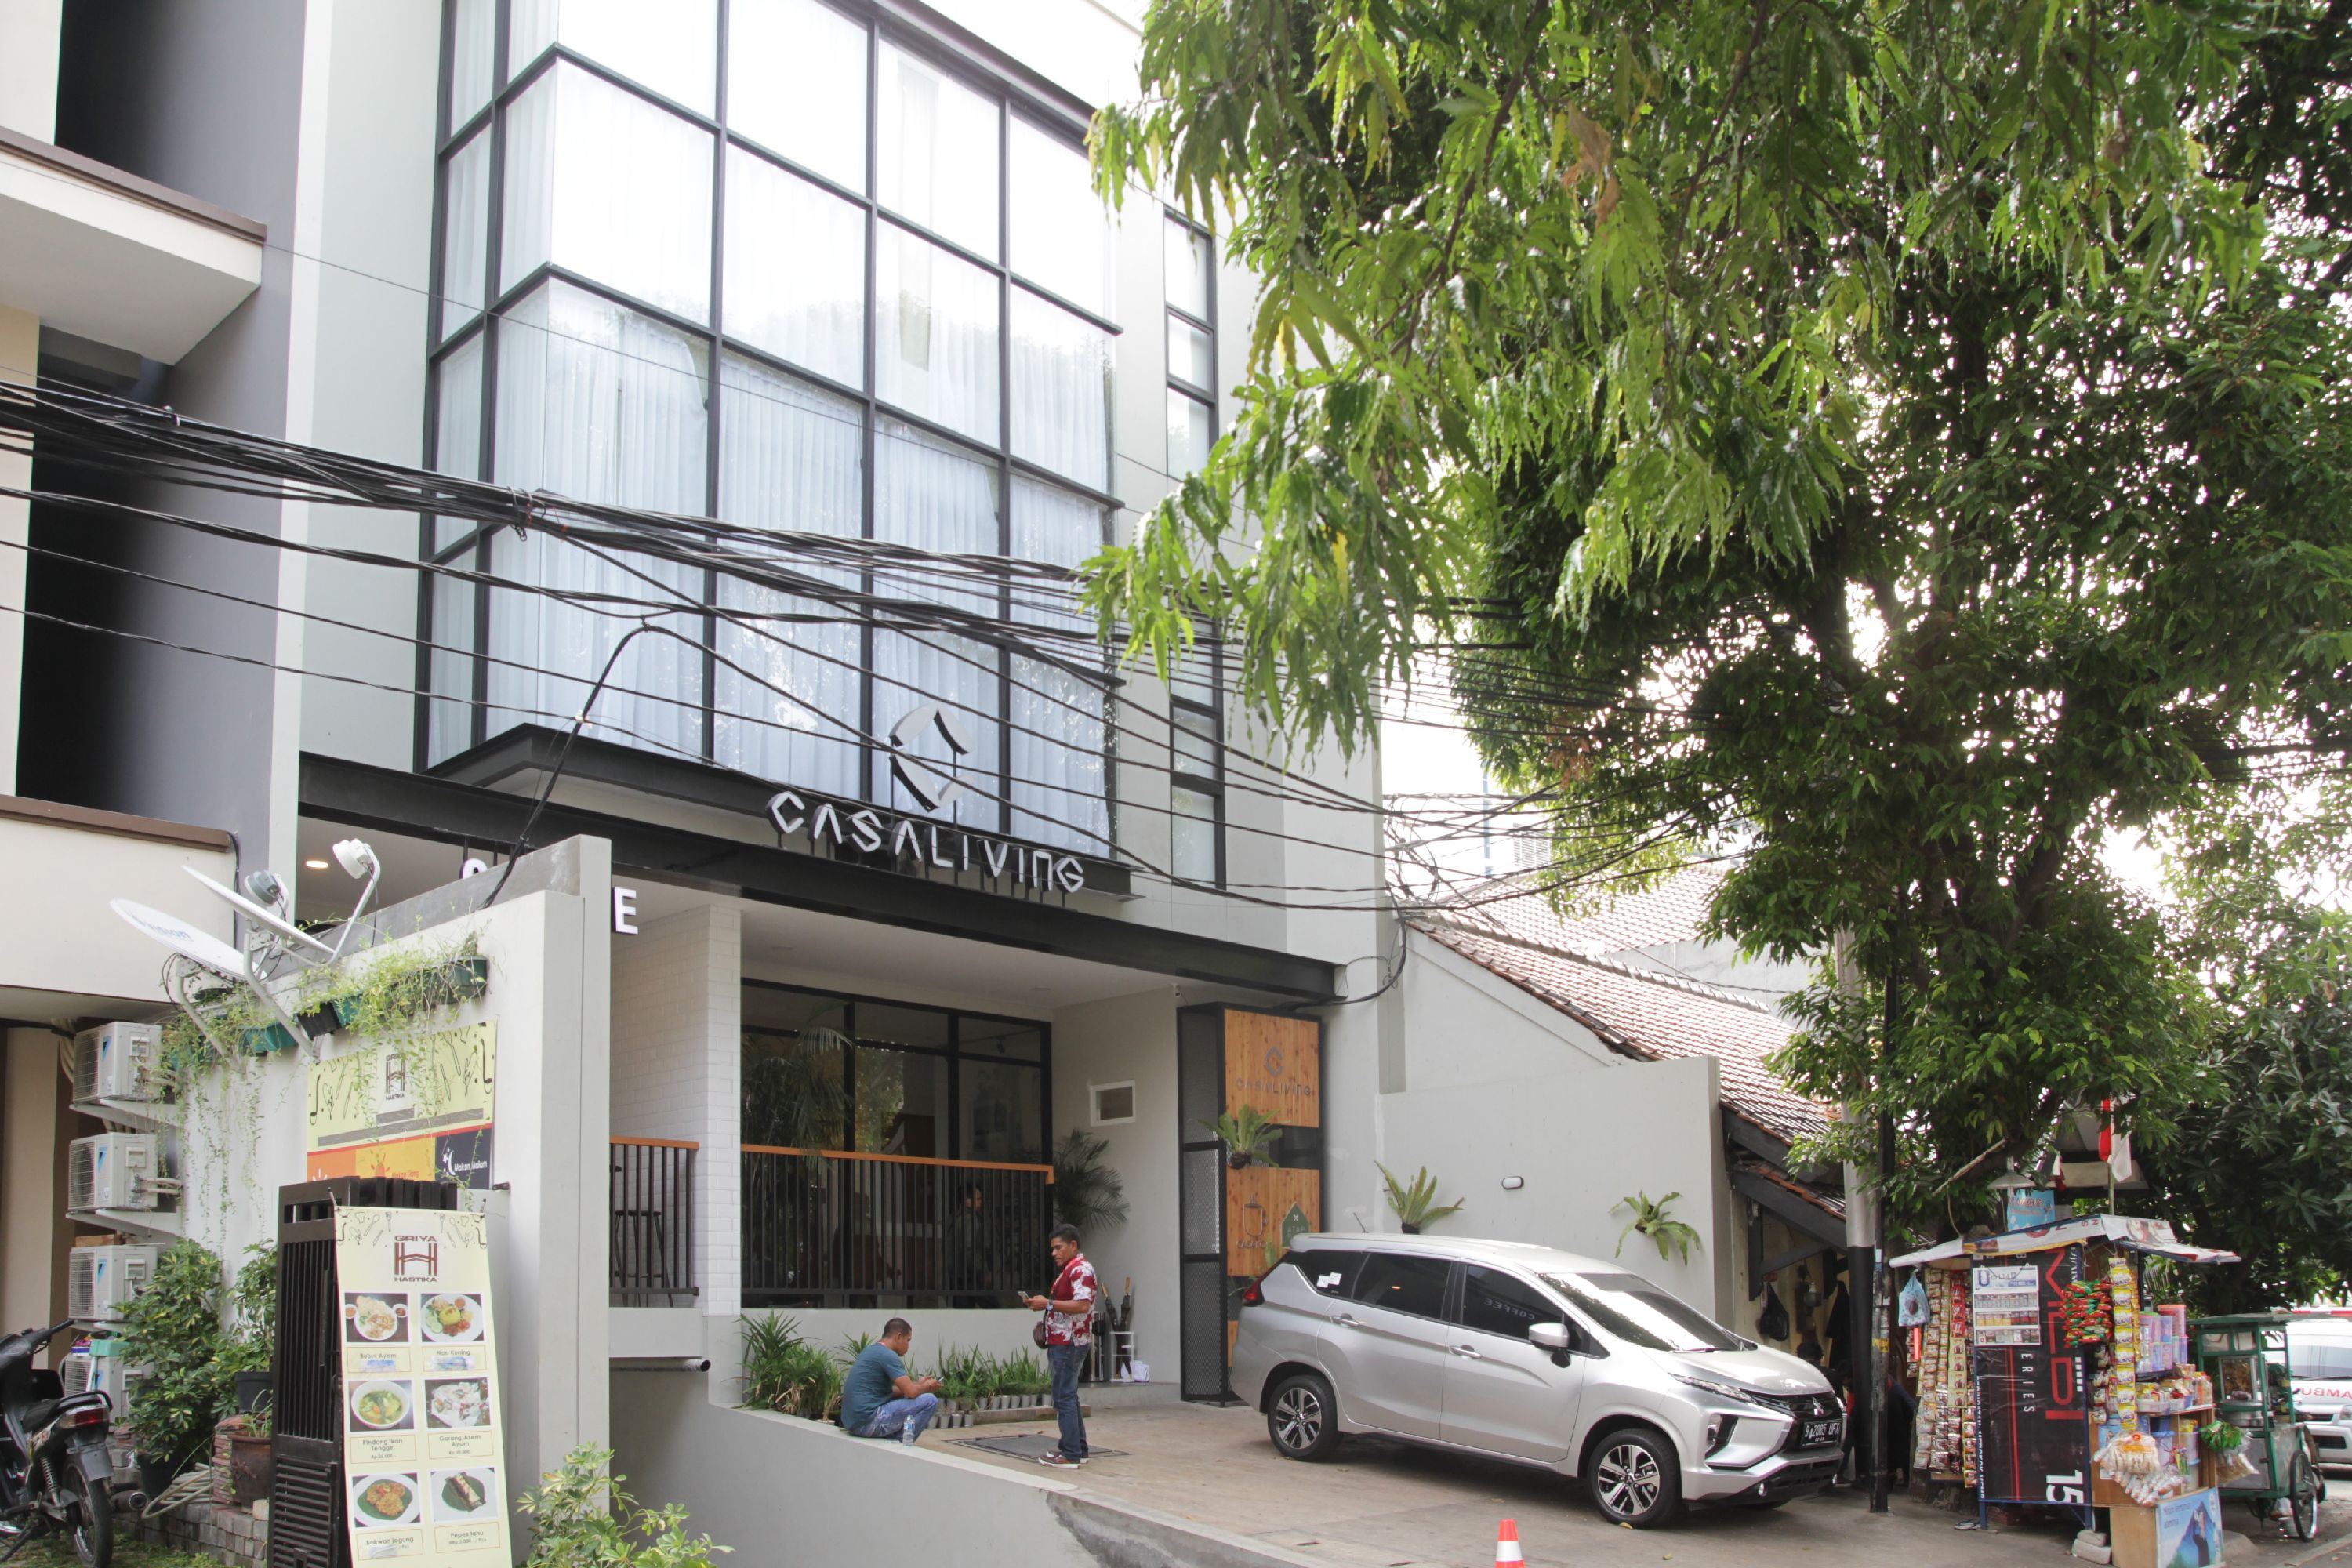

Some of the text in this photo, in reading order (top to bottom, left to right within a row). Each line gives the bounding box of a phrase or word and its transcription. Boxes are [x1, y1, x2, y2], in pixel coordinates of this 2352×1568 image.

[765, 790, 1084, 894] CASALIVING
[1236, 1077, 1312, 1097] CASALIVING
[454, 1163, 470, 1172] Makan
[2020, 1353, 2035, 1413] ERIES
[2045, 1469, 2085, 1504] 15
